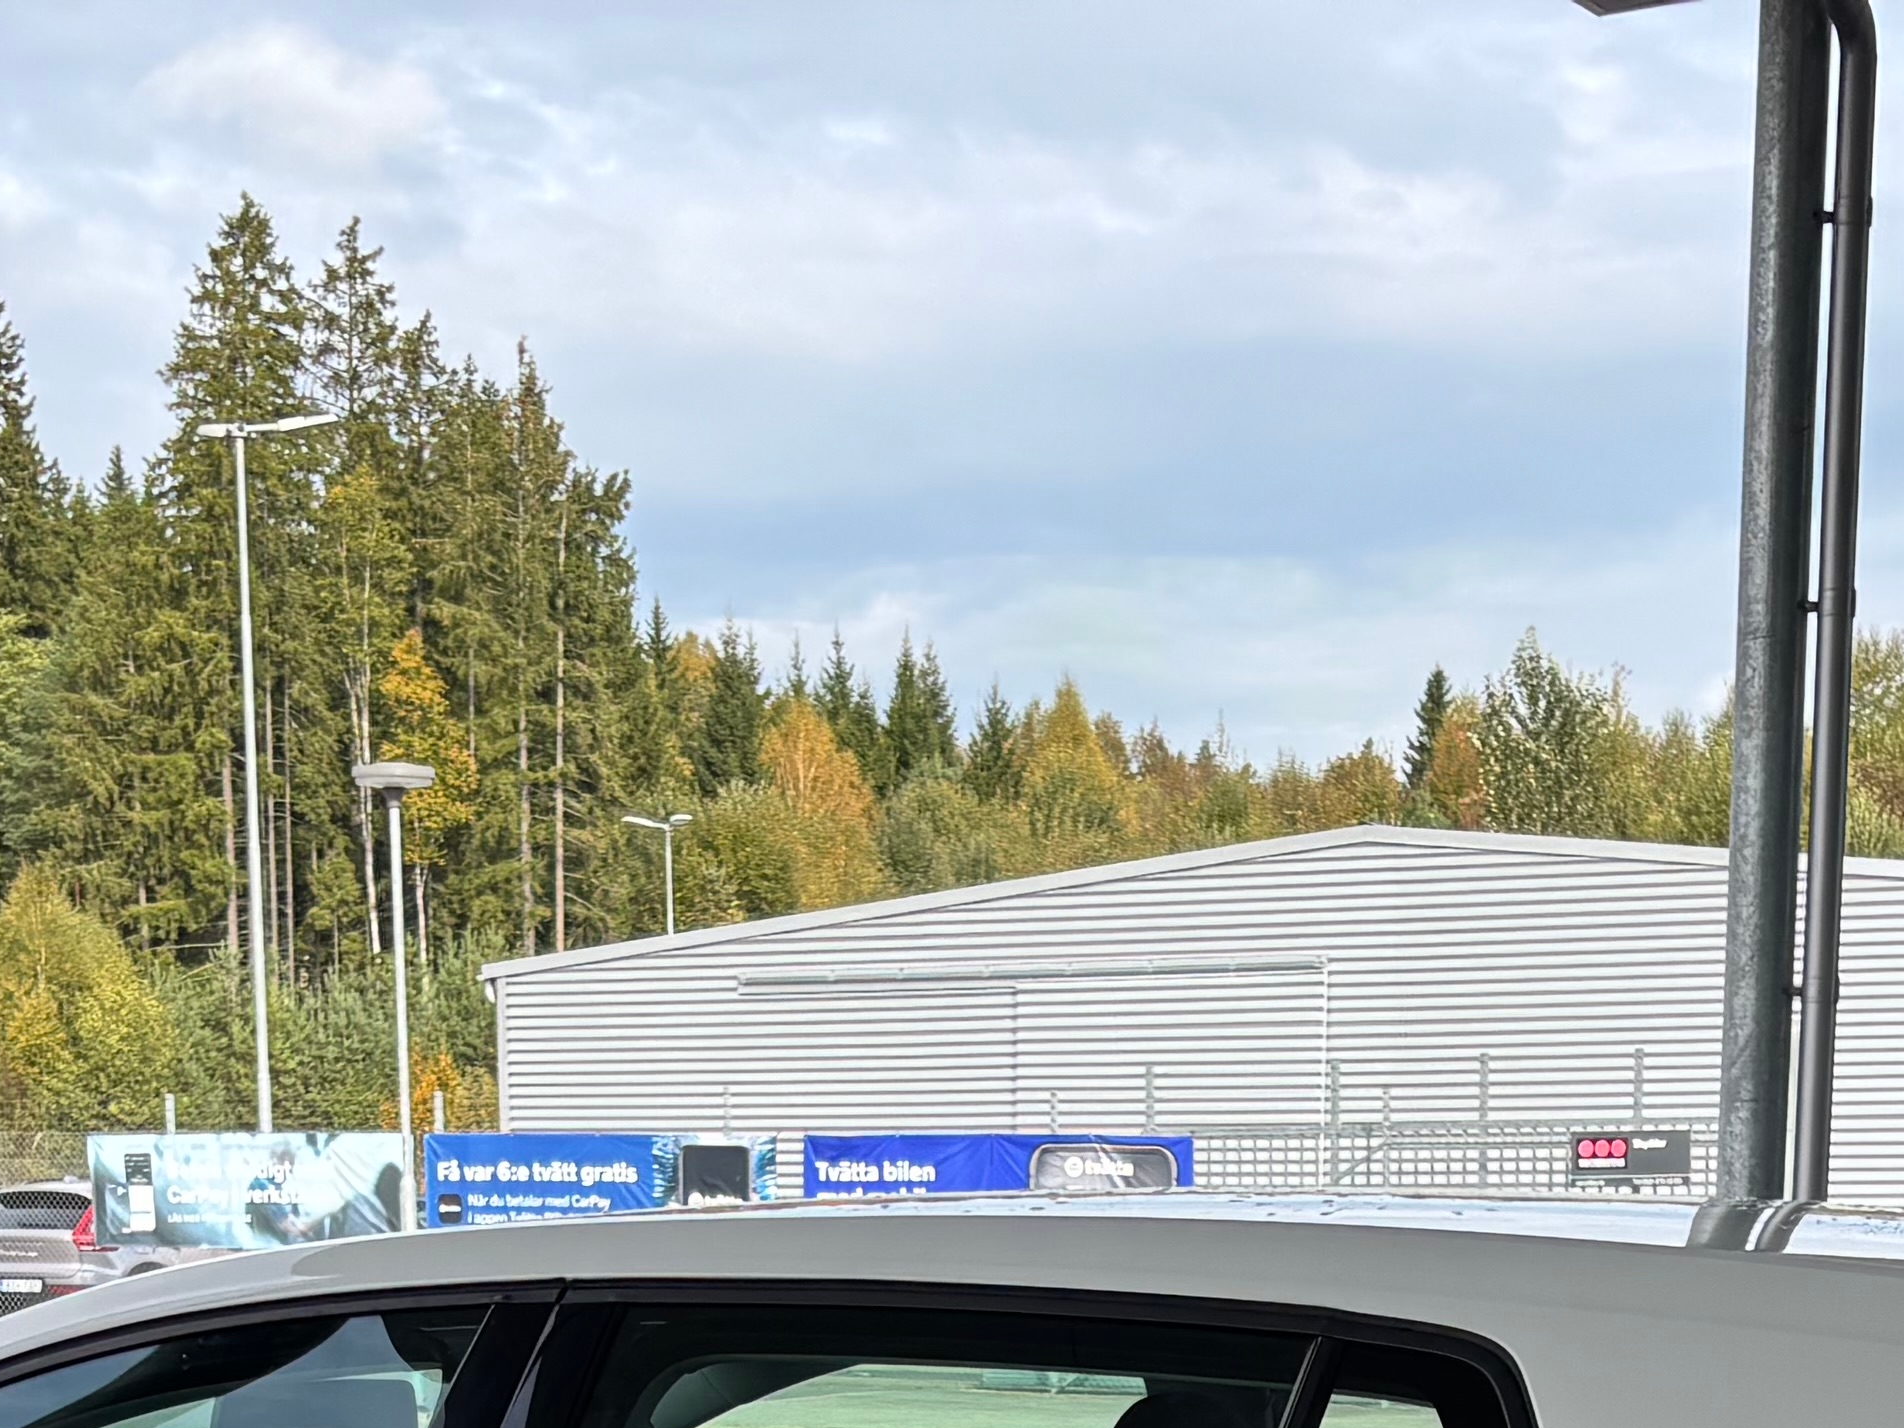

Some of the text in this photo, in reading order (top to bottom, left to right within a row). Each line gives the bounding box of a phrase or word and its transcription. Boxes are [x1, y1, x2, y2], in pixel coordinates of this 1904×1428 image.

[436, 1159, 639, 1187] Få var 6:e tvätt gratis
[815, 1161, 936, 1183] Tvätta bilen
